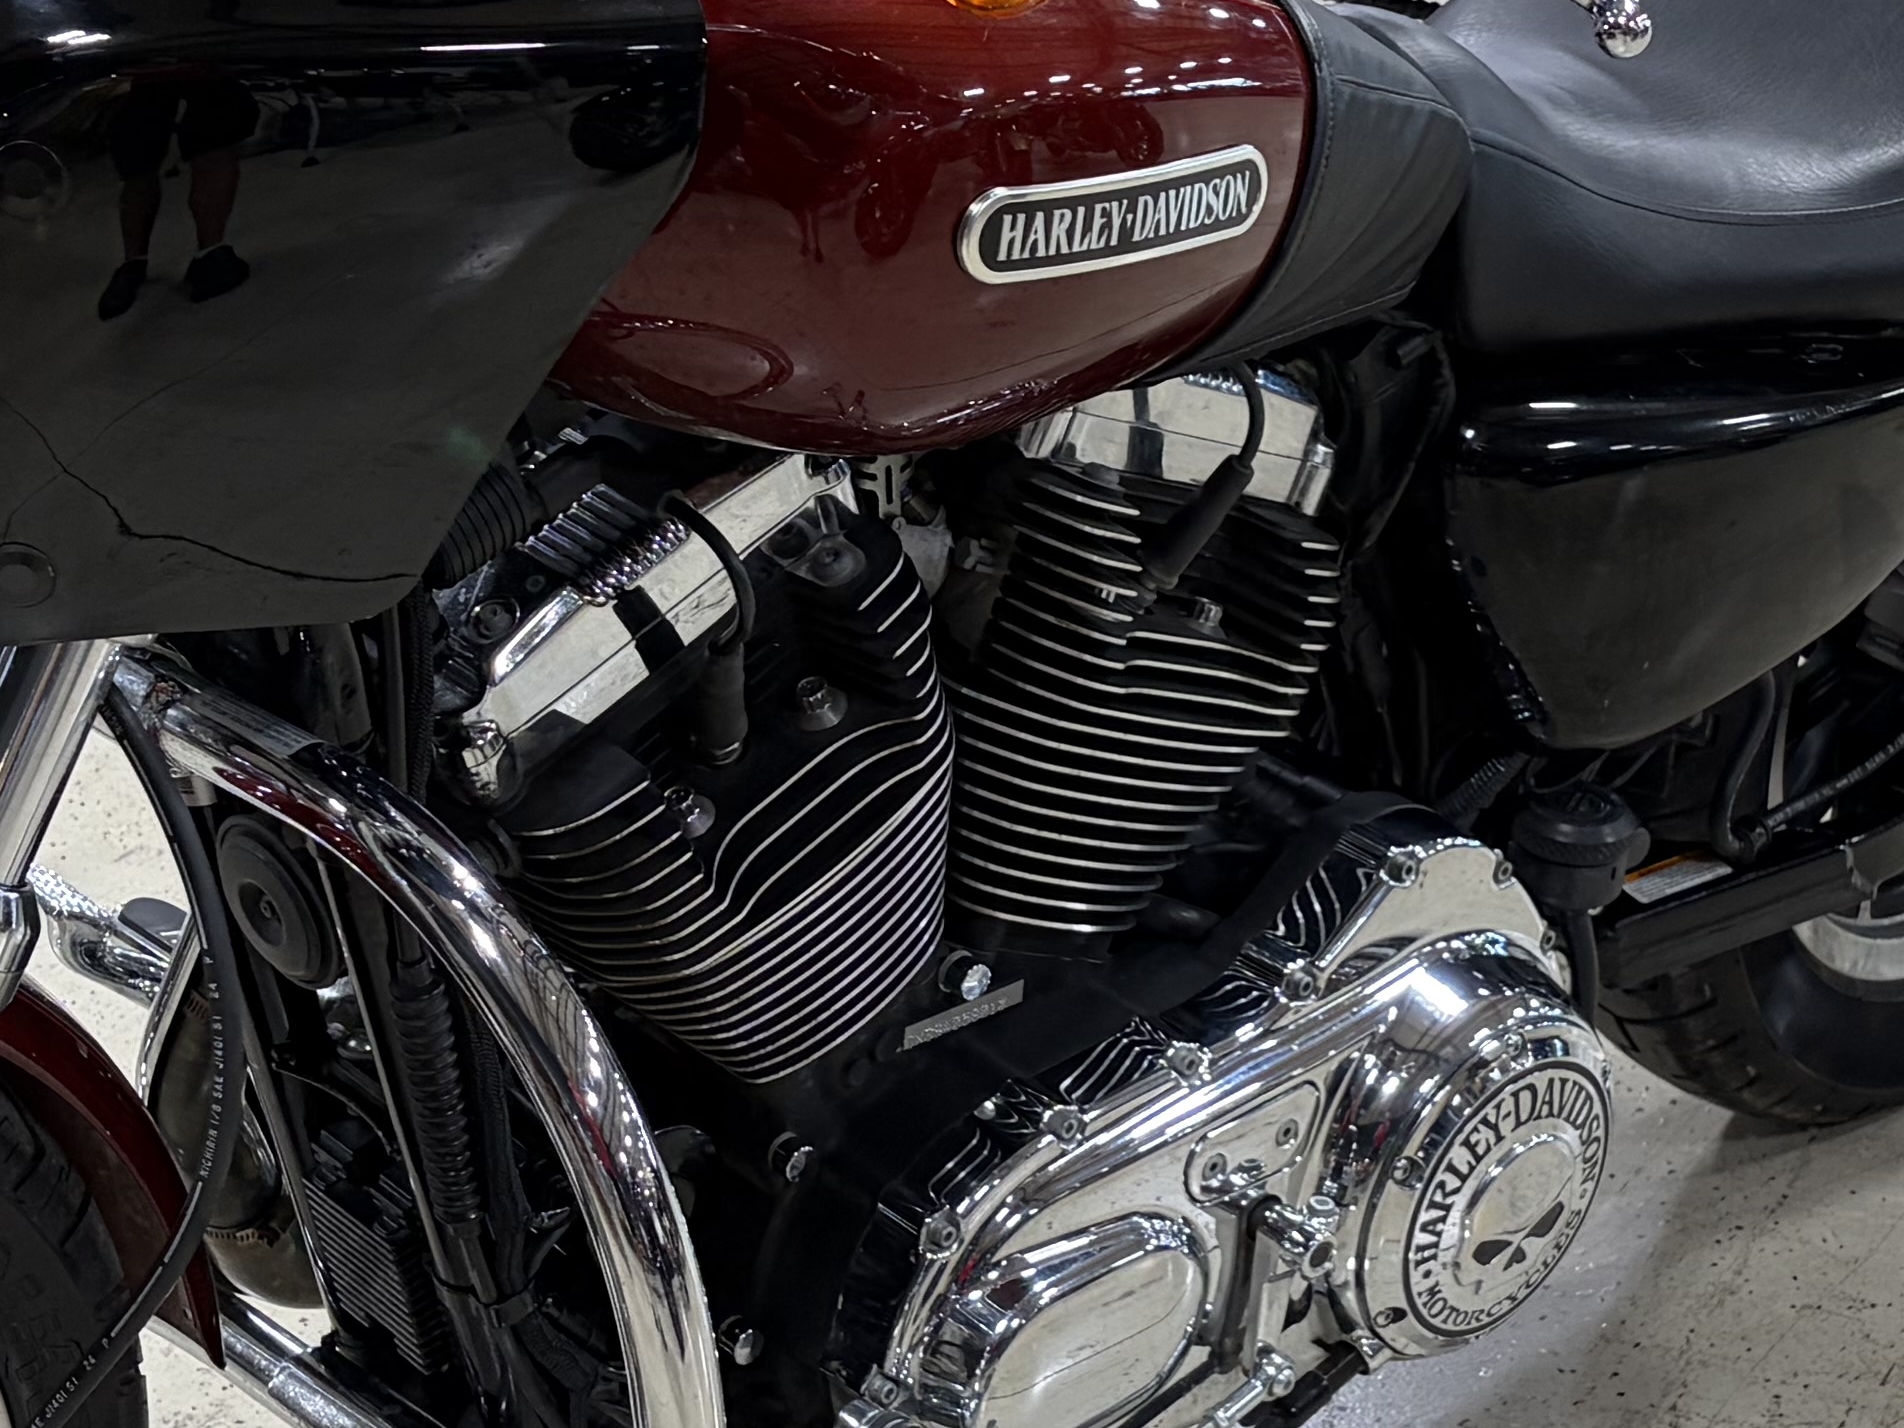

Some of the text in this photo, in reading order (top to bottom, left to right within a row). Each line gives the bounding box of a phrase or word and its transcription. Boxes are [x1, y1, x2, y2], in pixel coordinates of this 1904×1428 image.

[996, 170, 1250, 262] HARLEY-DAVIDSON
[212, 1076, 224, 1099] SAE
[1414, 1077, 1601, 1271] HARLEY-DAVIDSON
[1417, 1208, 1581, 1326] MOTORCYCLES
